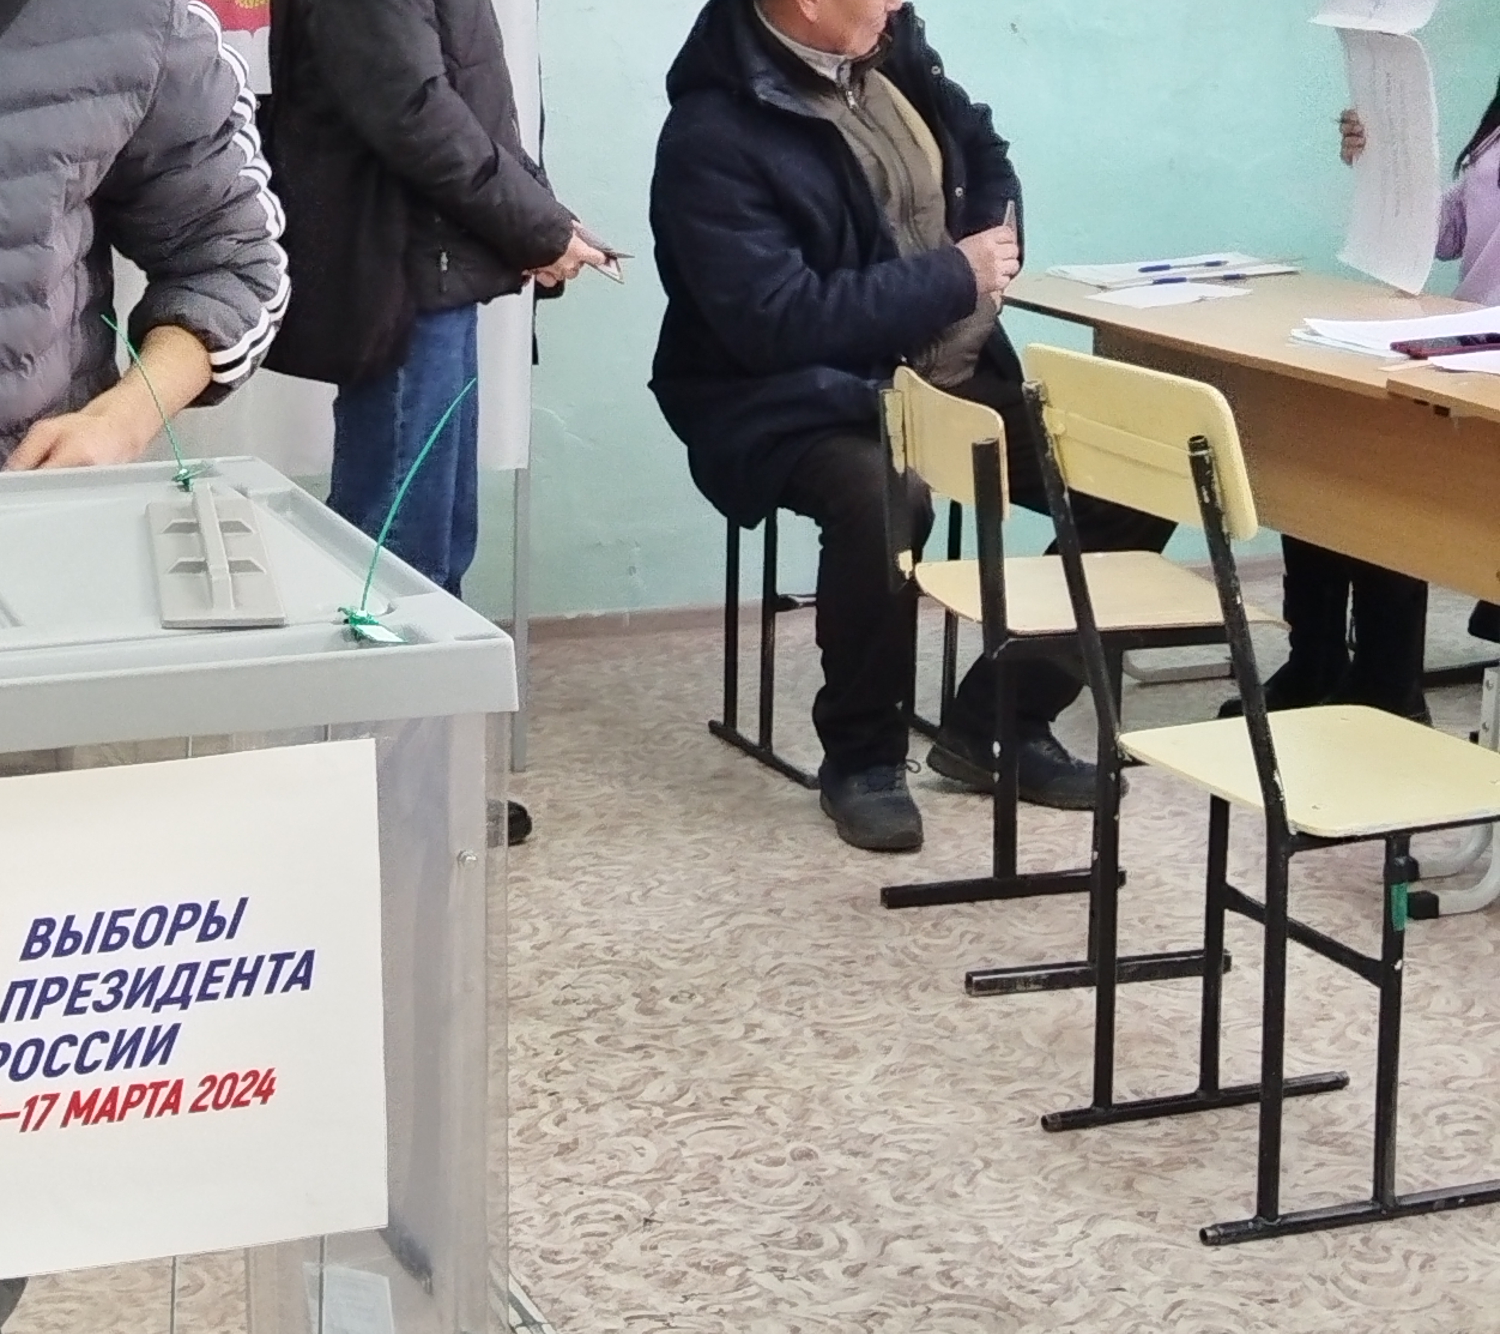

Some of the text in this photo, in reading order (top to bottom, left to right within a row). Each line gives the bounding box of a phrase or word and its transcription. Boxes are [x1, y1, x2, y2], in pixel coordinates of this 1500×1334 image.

[19, 897, 249, 961] ВЫБОРЫ
[60, 1078, 184, 1128] МАРТА
[188, 1068, 277, 1114] 2024
